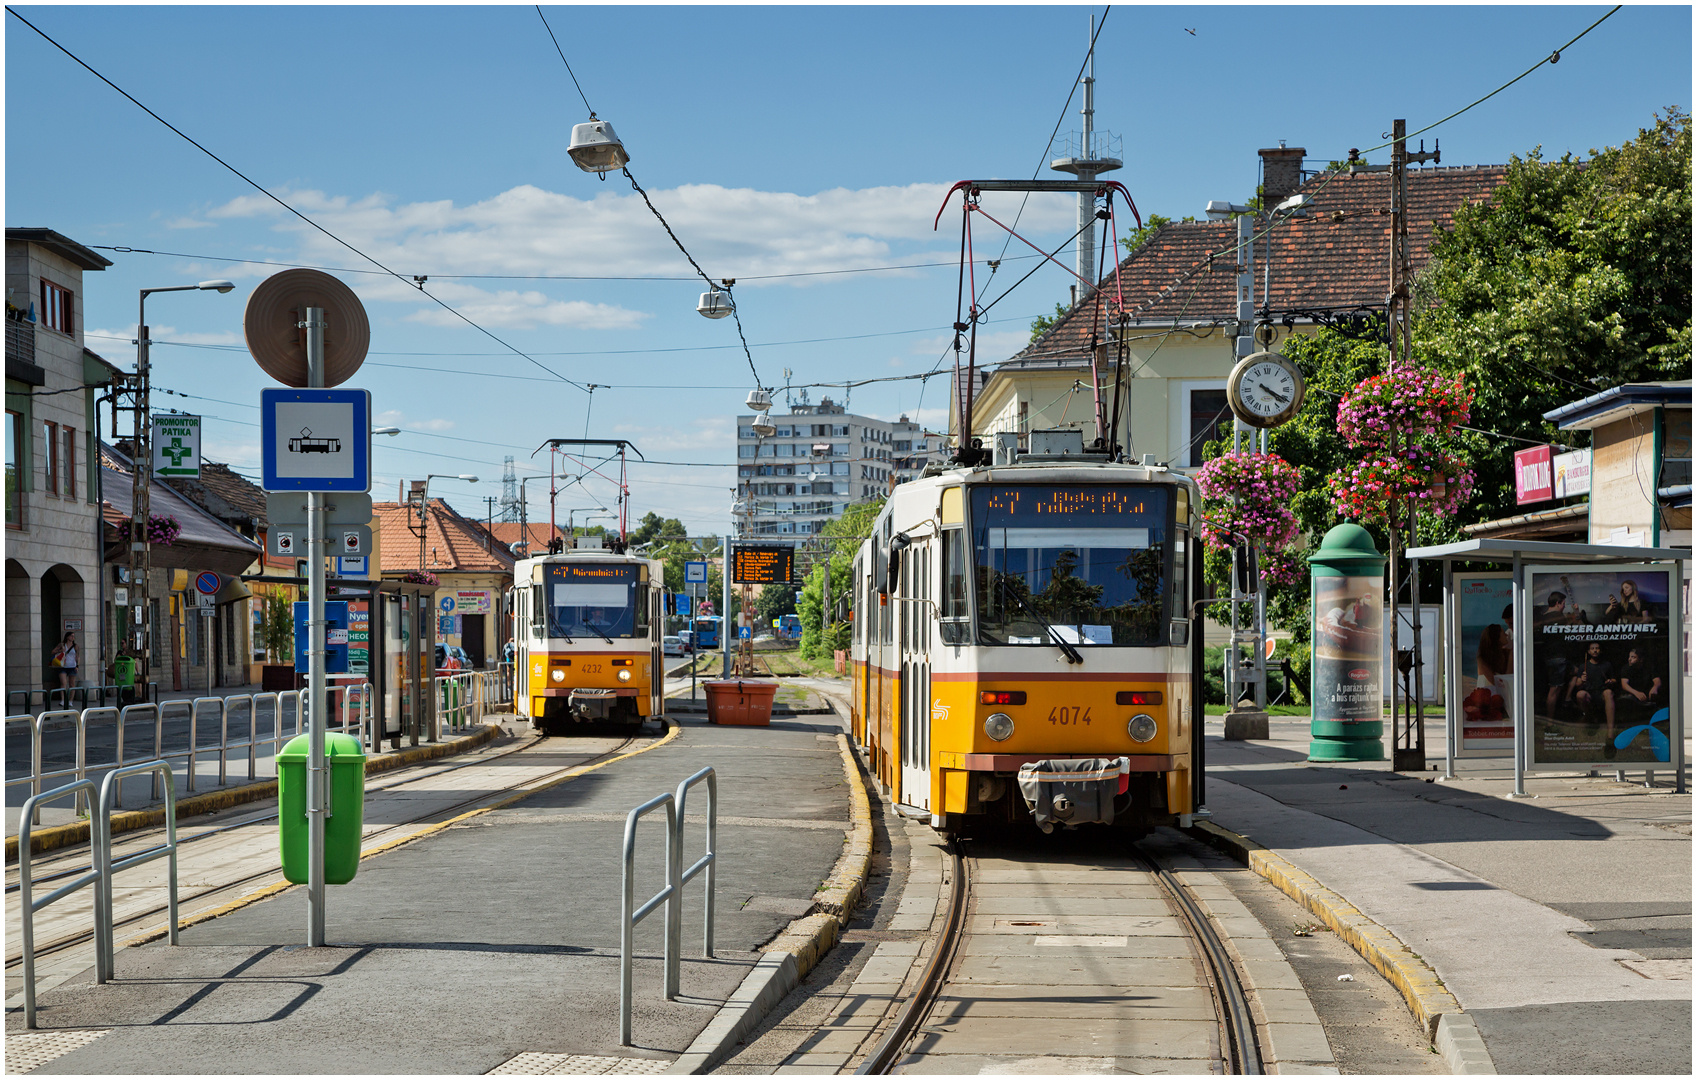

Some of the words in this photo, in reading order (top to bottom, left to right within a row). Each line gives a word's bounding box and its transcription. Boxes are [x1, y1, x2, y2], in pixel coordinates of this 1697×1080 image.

[155, 418, 199, 427] PROMONTOR
[162, 428, 191, 436] PATIKA
[1543, 622, 1593, 634] KÉTSZER
[1594, 624, 1632, 633] ANNYI
[1633, 623, 1659, 634] NET,
[581, 664, 602, 674] 4232
[1336, 683, 1341, 693] A
[1343, 683, 1363, 694] parázs
[1048, 706, 1092, 726] 4074
